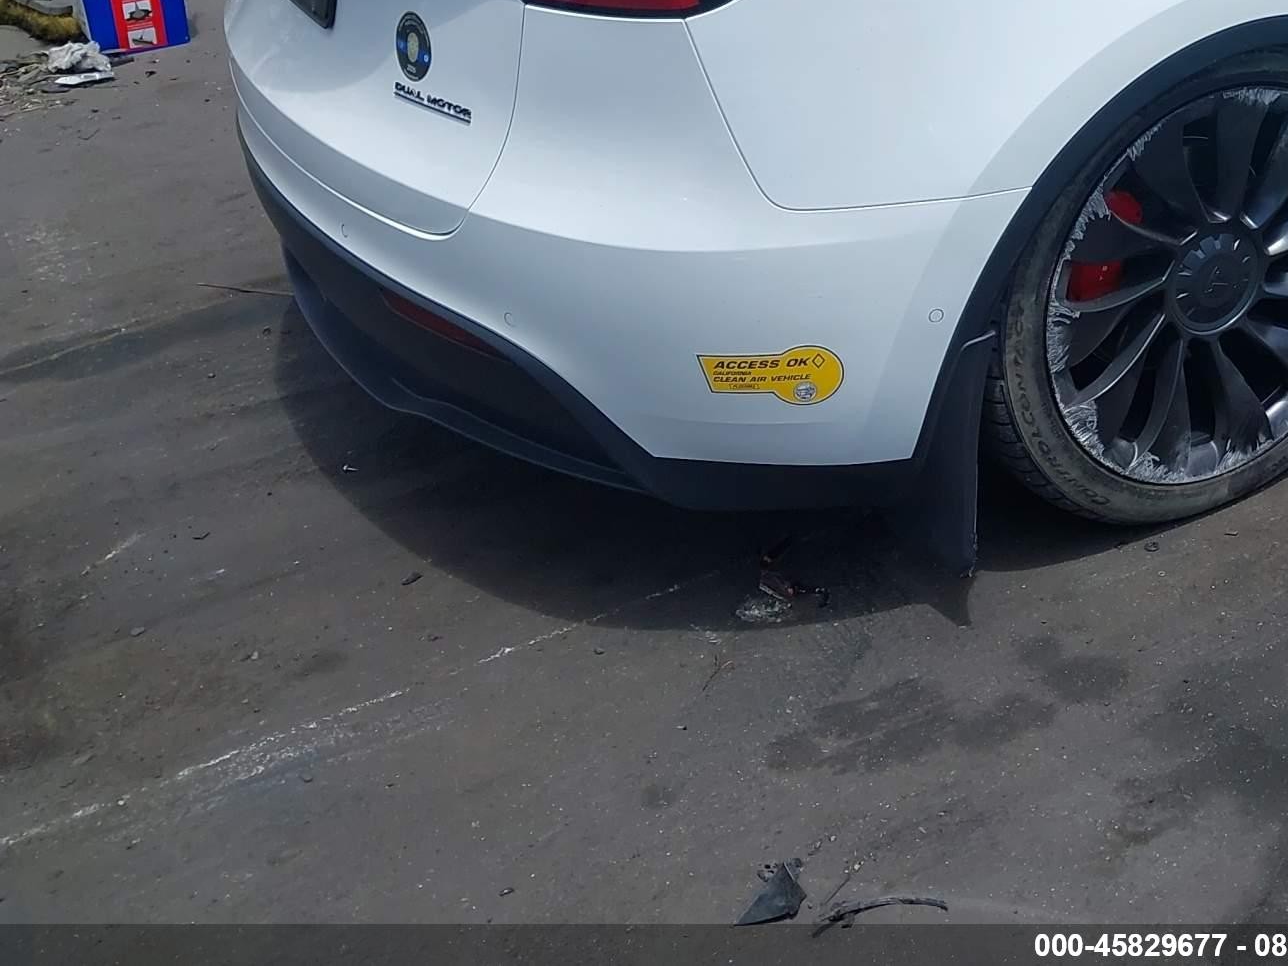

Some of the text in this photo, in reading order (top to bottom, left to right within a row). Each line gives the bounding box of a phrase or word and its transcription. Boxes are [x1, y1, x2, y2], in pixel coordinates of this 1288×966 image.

[395, 82, 472, 119] DUAL MOTOR
[713, 357, 811, 370] ACCESS OK
[770, 374, 812, 382] VEHICLE
